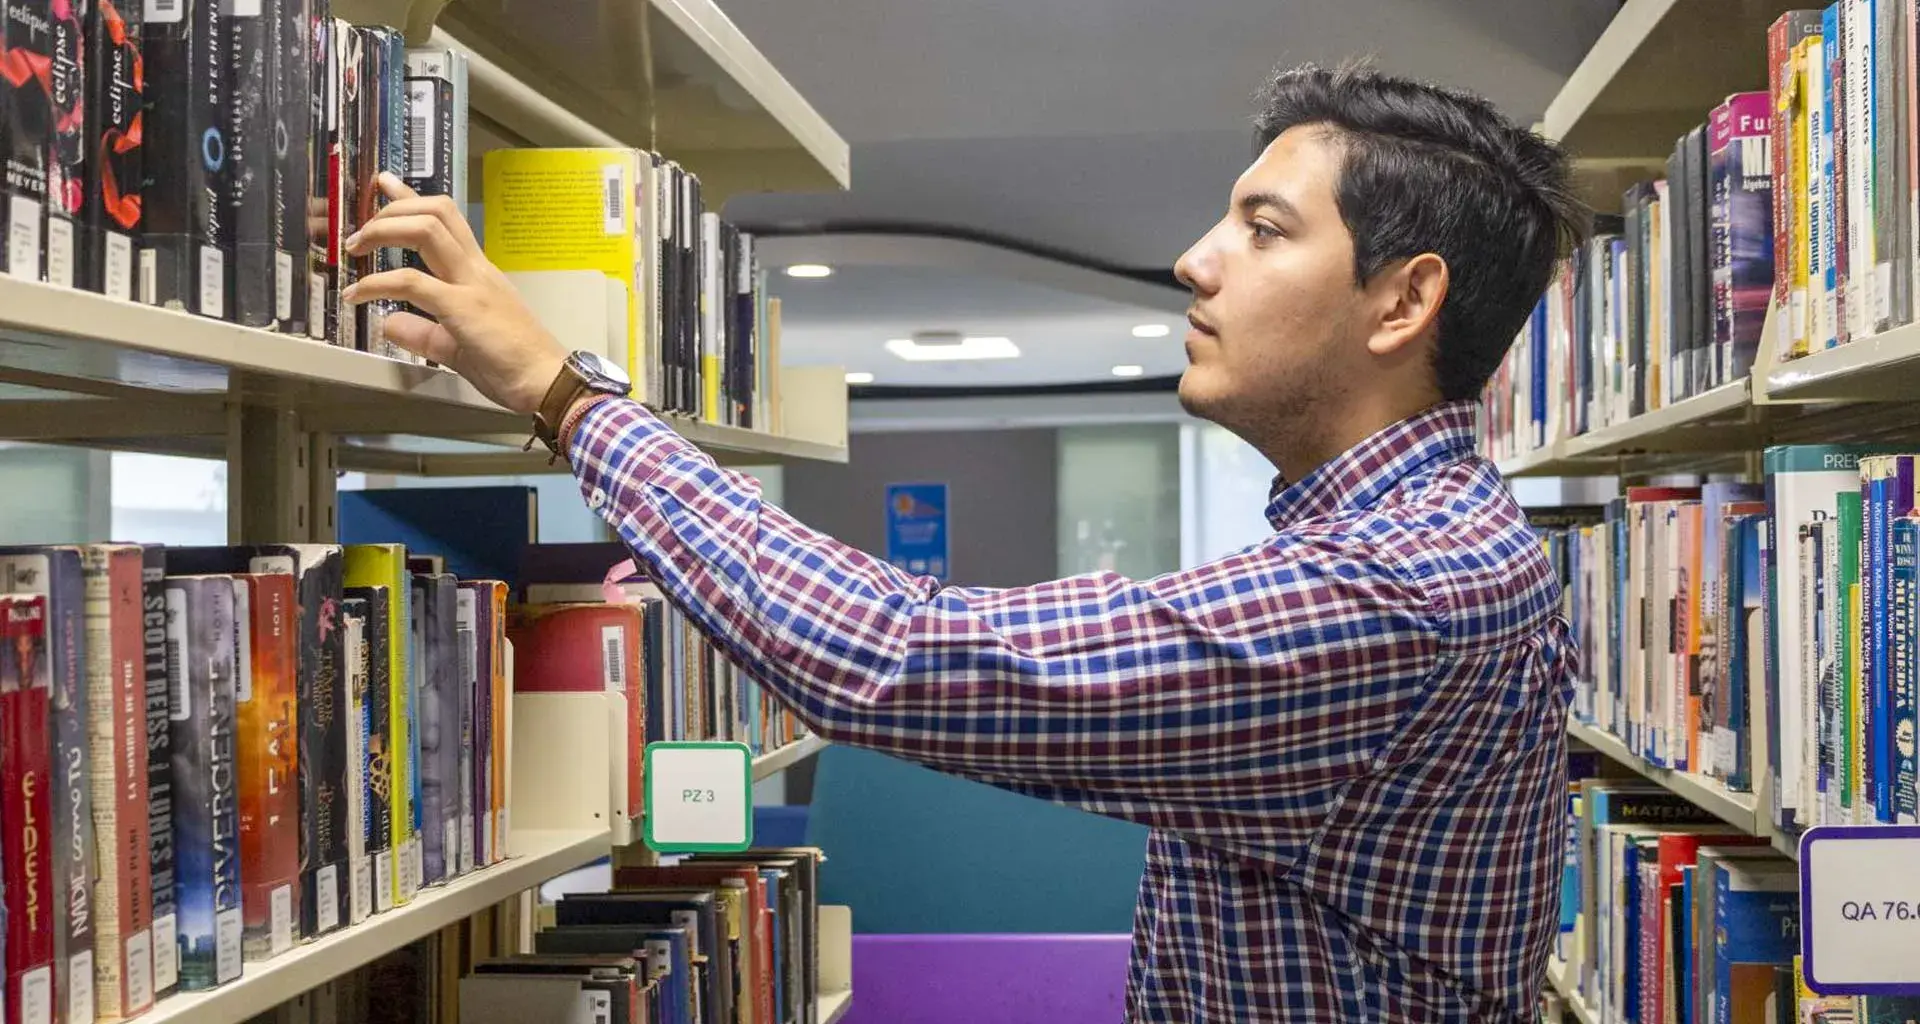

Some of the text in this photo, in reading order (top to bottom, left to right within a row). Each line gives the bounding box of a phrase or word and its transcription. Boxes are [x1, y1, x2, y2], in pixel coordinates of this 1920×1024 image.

[53, 25, 77, 104] eclipse
[113, 50, 133, 124] eclipse
[1860, 45, 1870, 145] Computers
[403, 94, 412, 172] destino
[7, 171, 46, 192] MEYER
[1810, 201, 1820, 275] Simulación
[1862, 500, 1871, 572] Multimedia:
[1874, 502, 1882, 565] Multimedia:
[272, 592, 281, 637] ROTH
[1863, 576, 1872, 622] Making
[1874, 569, 1883, 607] Making
[1887, 563, 1895, 600] Making
[144, 596, 167, 671] SCOTT
[1864, 637, 1873, 669] Work
[1875, 623, 1883, 650] Work
[1896, 578, 1906, 708] MULTIMEDIA
[123, 660, 137, 801] LA SOMBRA DE POE
[147, 679, 170, 748] REISS
[209, 657, 236, 911] DIVERGENTE
[682, 789, 715, 802] PZ 3
[21, 772, 38, 931] ELDEST
[70, 788, 85, 861] como
[149, 786, 173, 864] LUNES
[70, 866, 88, 938] NADIE
[1842, 901, 1877, 921] QA
